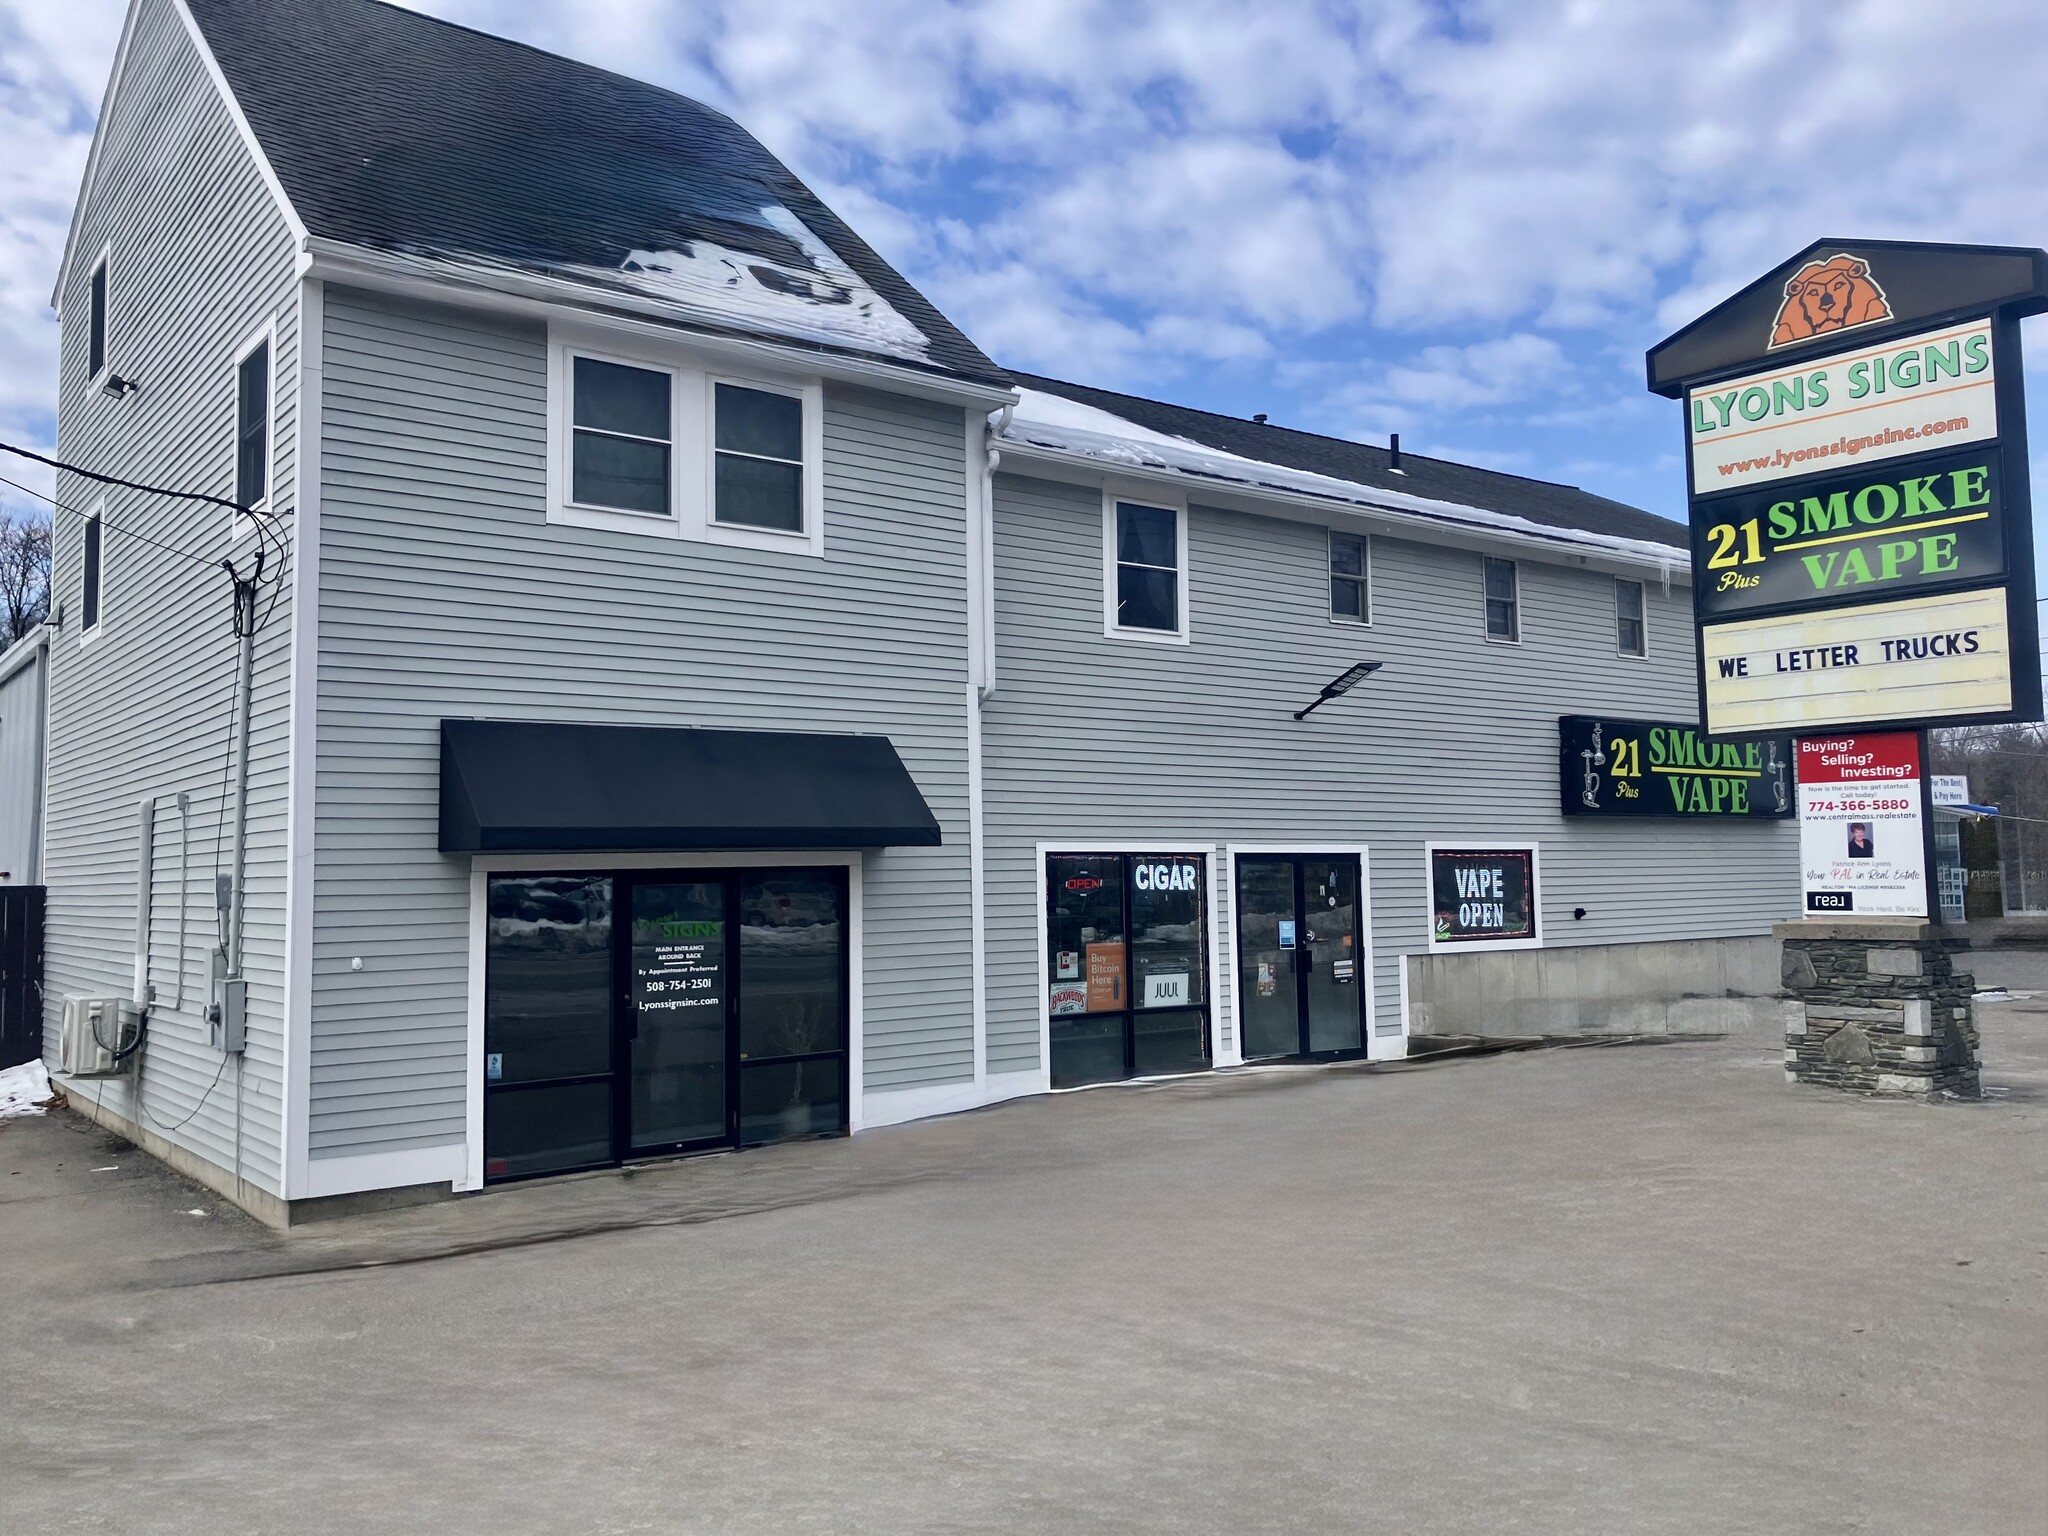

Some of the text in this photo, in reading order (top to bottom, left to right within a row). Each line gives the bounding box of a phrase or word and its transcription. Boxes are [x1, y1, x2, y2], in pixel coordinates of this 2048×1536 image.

[1694, 334, 1990, 433] LYONS SIGNS
[1717, 416, 1968, 476] www.lyonssignsinc.com
[1768, 466, 1991, 539] SMOKE
[1707, 517, 1766, 569] 21
[1801, 533, 1959, 589] VAPE
[1717, 571, 1760, 592] Plus
[1718, 631, 1979, 678] WE LETTER TRUCKS
[1649, 727, 1763, 769] SMOKE
[1802, 740, 1855, 753] Buying?
[1610, 738, 1642, 777] 21
[1821, 753, 1873, 766] Selling?
[1841, 764, 1912, 777] Investing?
[1615, 781, 1639, 798] Plus
[1940, 778, 1949, 786] The
[1668, 776, 1749, 813] VAPE
[1809, 799, 1909, 811] 774-366-5880
[1805, 812, 1917, 820] www.centralmass.realestate
[1135, 864, 1195, 890] CIGAR
[1830, 868, 1853, 880] PAL
[1856, 871, 1864, 879] in
[1868, 869, 1889, 880] Real
[1893, 869, 1920, 880] Estate
[1068, 878, 1100, 889] OPEN
[1455, 868, 1504, 898] VAPE
[1815, 895, 1845, 906] real
[1459, 903, 1504, 928] OPEN
[663, 922, 720, 938] SIGNS
[1091, 953, 1106, 964] Buy
[648, 967, 688, 975] Appointment
[1092, 964, 1119, 974] Bitcoin
[646, 978, 711, 992] 508-754-2501
[1091, 975, 1112, 985] Here
[1155, 982, 1179, 998] JUUL
[639, 998, 719, 1012] Lyonssignsinc.com
